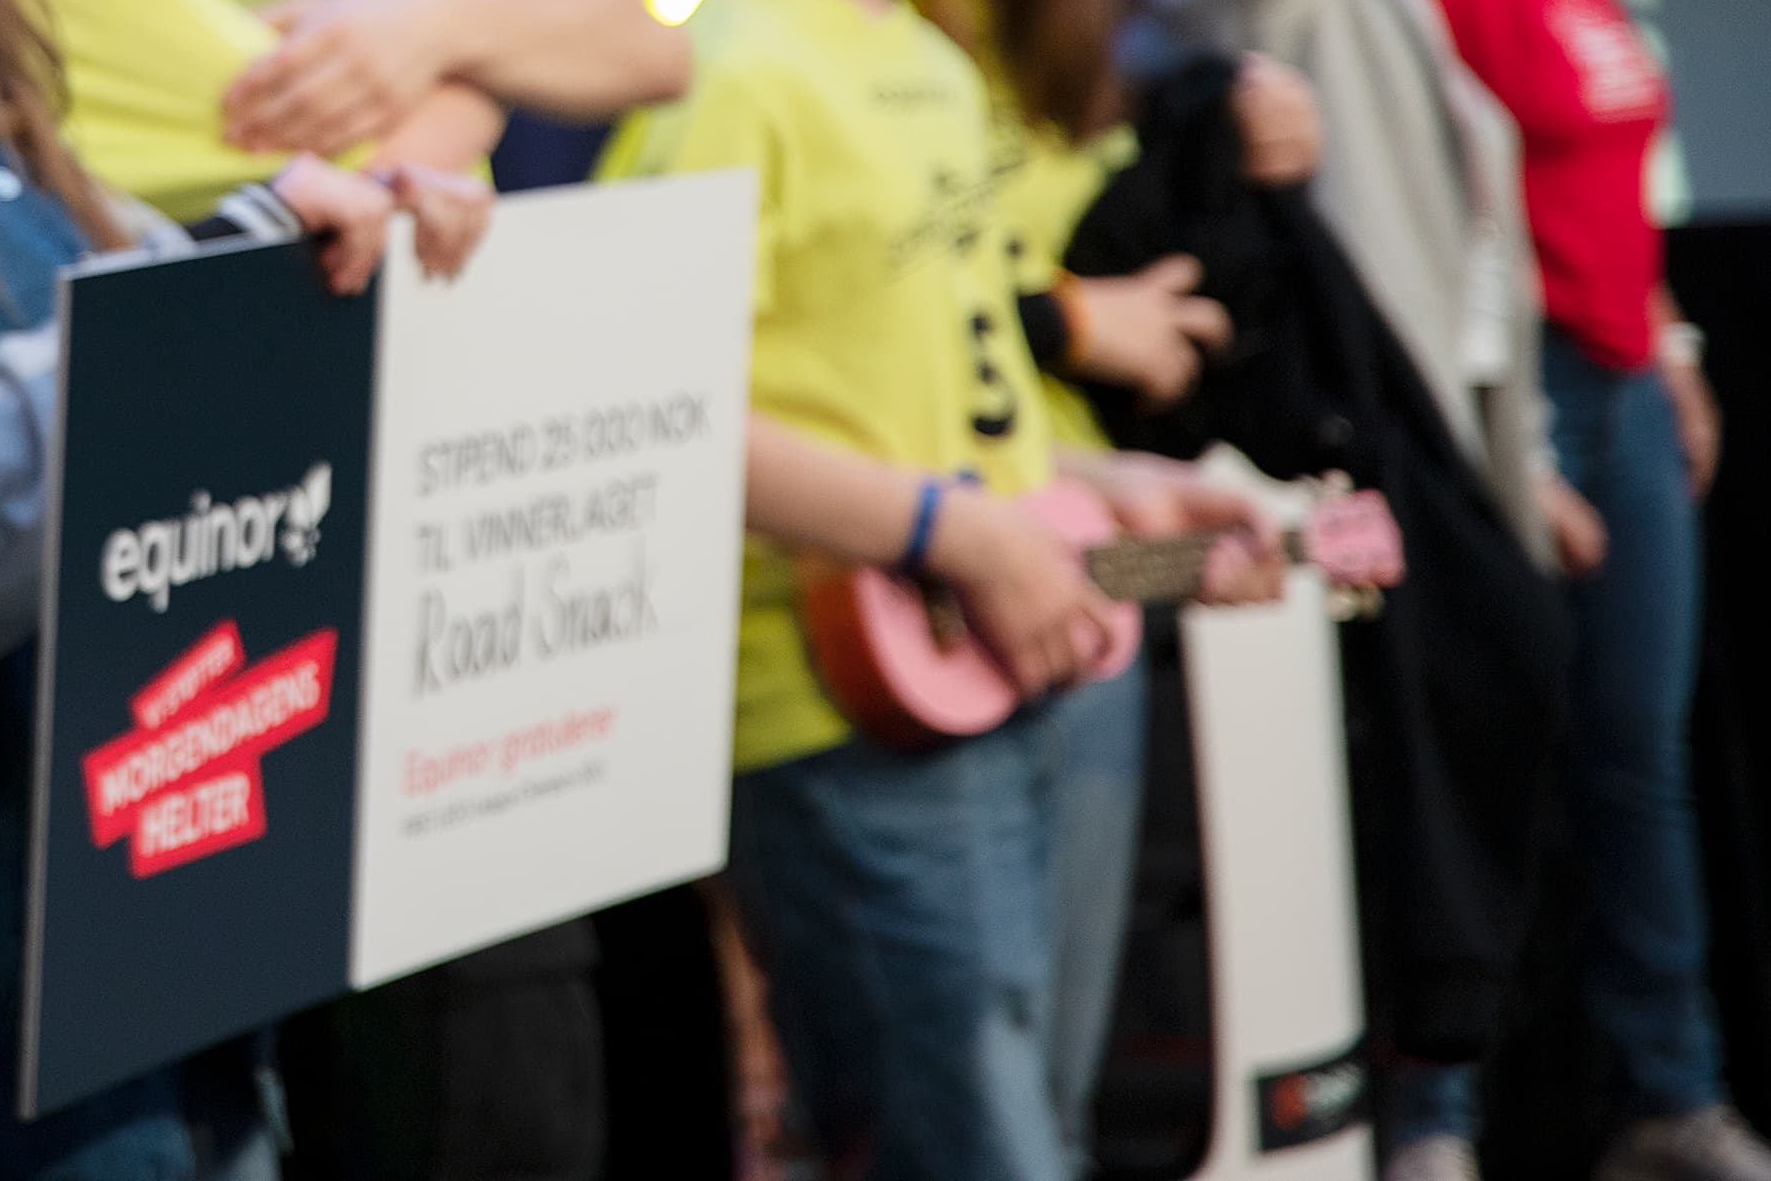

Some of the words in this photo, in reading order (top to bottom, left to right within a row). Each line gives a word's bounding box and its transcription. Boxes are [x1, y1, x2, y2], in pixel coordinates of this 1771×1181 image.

[416, 423, 539, 499] STIPEND
[584, 403, 646, 464] 000
[648, 391, 713, 445] NOK
[101, 488, 286, 613] equinor
[464, 472, 658, 561] VINNERLAGET
[413, 562, 525, 699] Road
[531, 532, 660, 660] Snack
[99, 661, 321, 817] MORGENDAGENS
[403, 742, 493, 798] Equinor
[139, 772, 250, 857] HELTER
